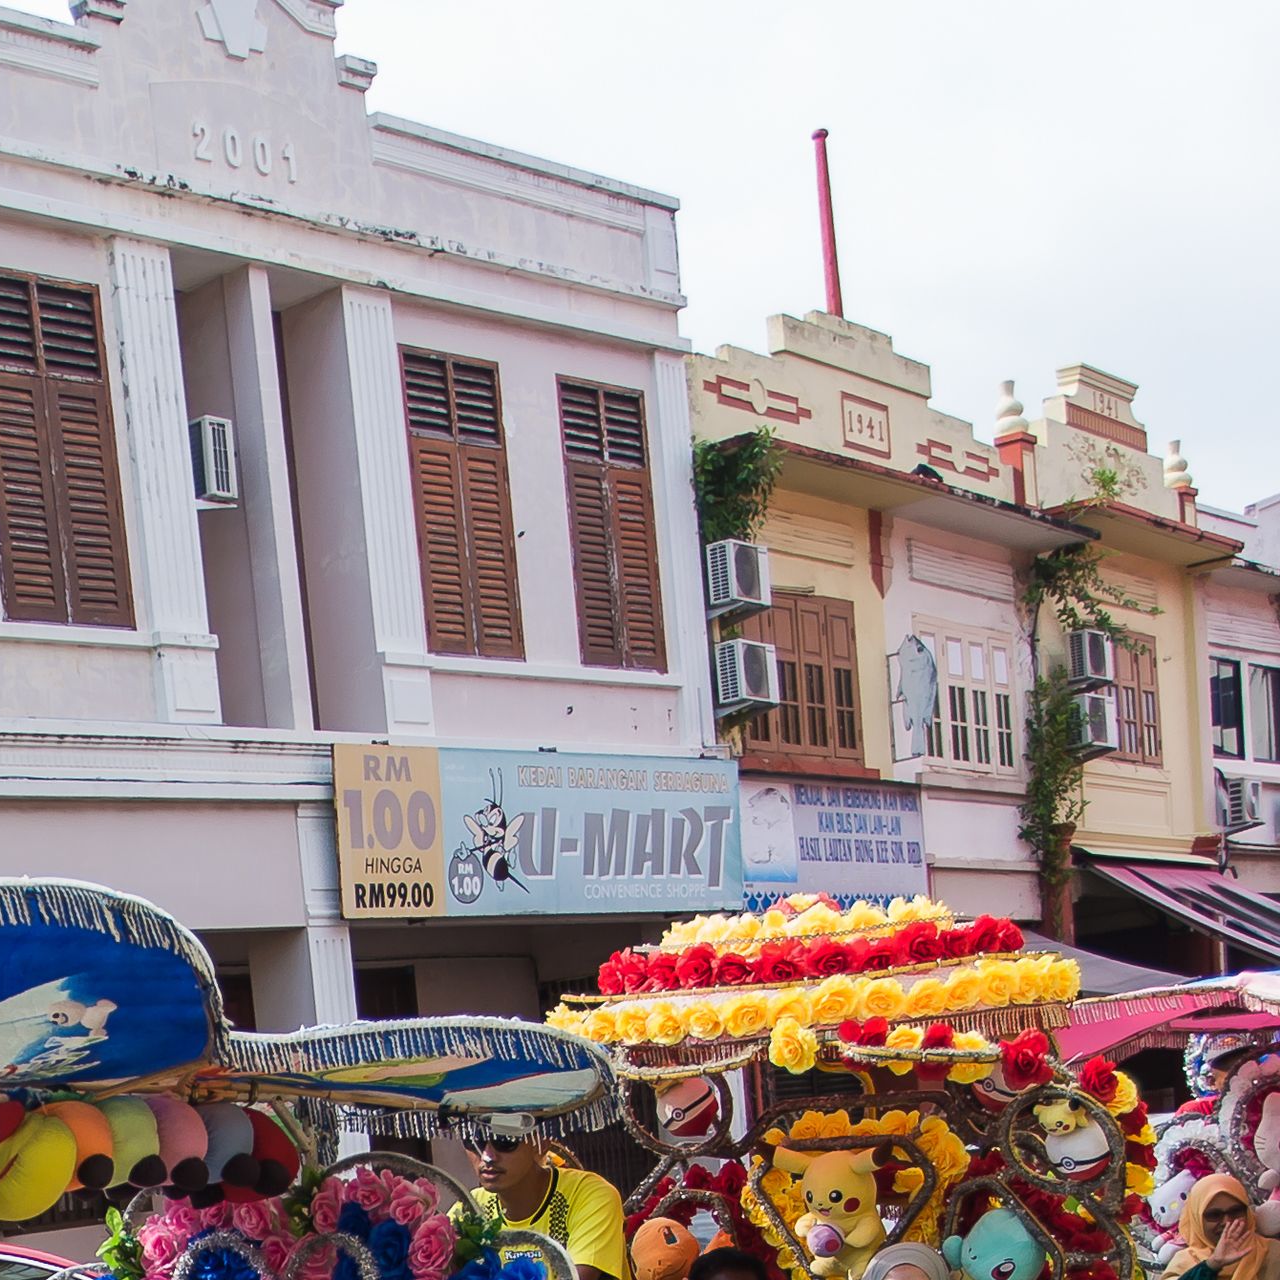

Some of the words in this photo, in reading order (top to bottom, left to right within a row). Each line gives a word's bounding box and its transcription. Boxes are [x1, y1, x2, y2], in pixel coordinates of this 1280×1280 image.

[192, 120, 297, 185] 2001
[848, 410, 884, 442] 1941
[363, 754, 412, 783] RM
[518, 765, 563, 787] KEDAI
[569, 767, 648, 791] BARANGAN
[654, 770, 729, 793] SERBAGUNA
[343, 789, 436, 850] 1.00
[853, 813, 868, 834] DAN
[519, 806, 734, 890] U-MART
[799, 837, 822, 861] HASIL
[823, 837, 853, 862] LAUTAN
[875, 840, 889, 864] KEE
[365, 857, 422, 874] HINGGA
[458, 863, 473, 874] RM
[355, 882, 434, 909] RM99.00
[452, 876, 480, 896] 1.00
[584, 883, 662, 899] CONVENIENCE
[666, 884, 706, 898] SHOPPE
